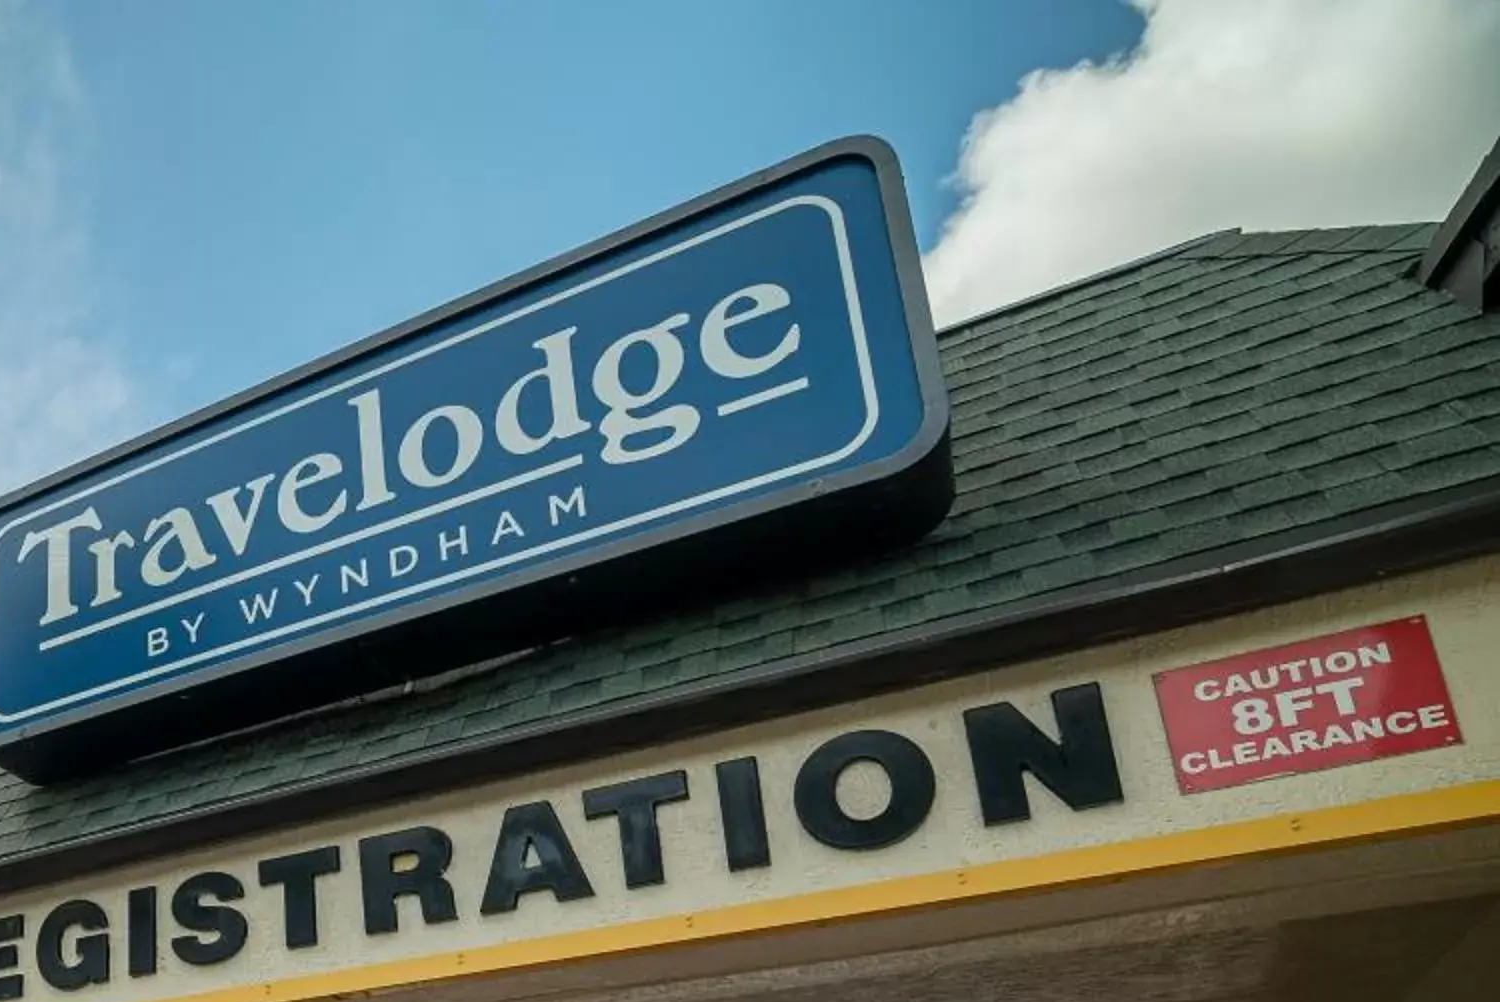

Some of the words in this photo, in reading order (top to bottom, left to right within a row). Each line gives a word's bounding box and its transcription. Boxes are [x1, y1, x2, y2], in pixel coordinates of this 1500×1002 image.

[16, 282, 801, 627] Travelodge
[146, 612, 206, 657] BY
[240, 485, 588, 624] WYNDHAM
[1194, 642, 1392, 701] CAUTION
[1231, 677, 1364, 735] 8FT
[1180, 704, 1449, 774] CLEARANCE
